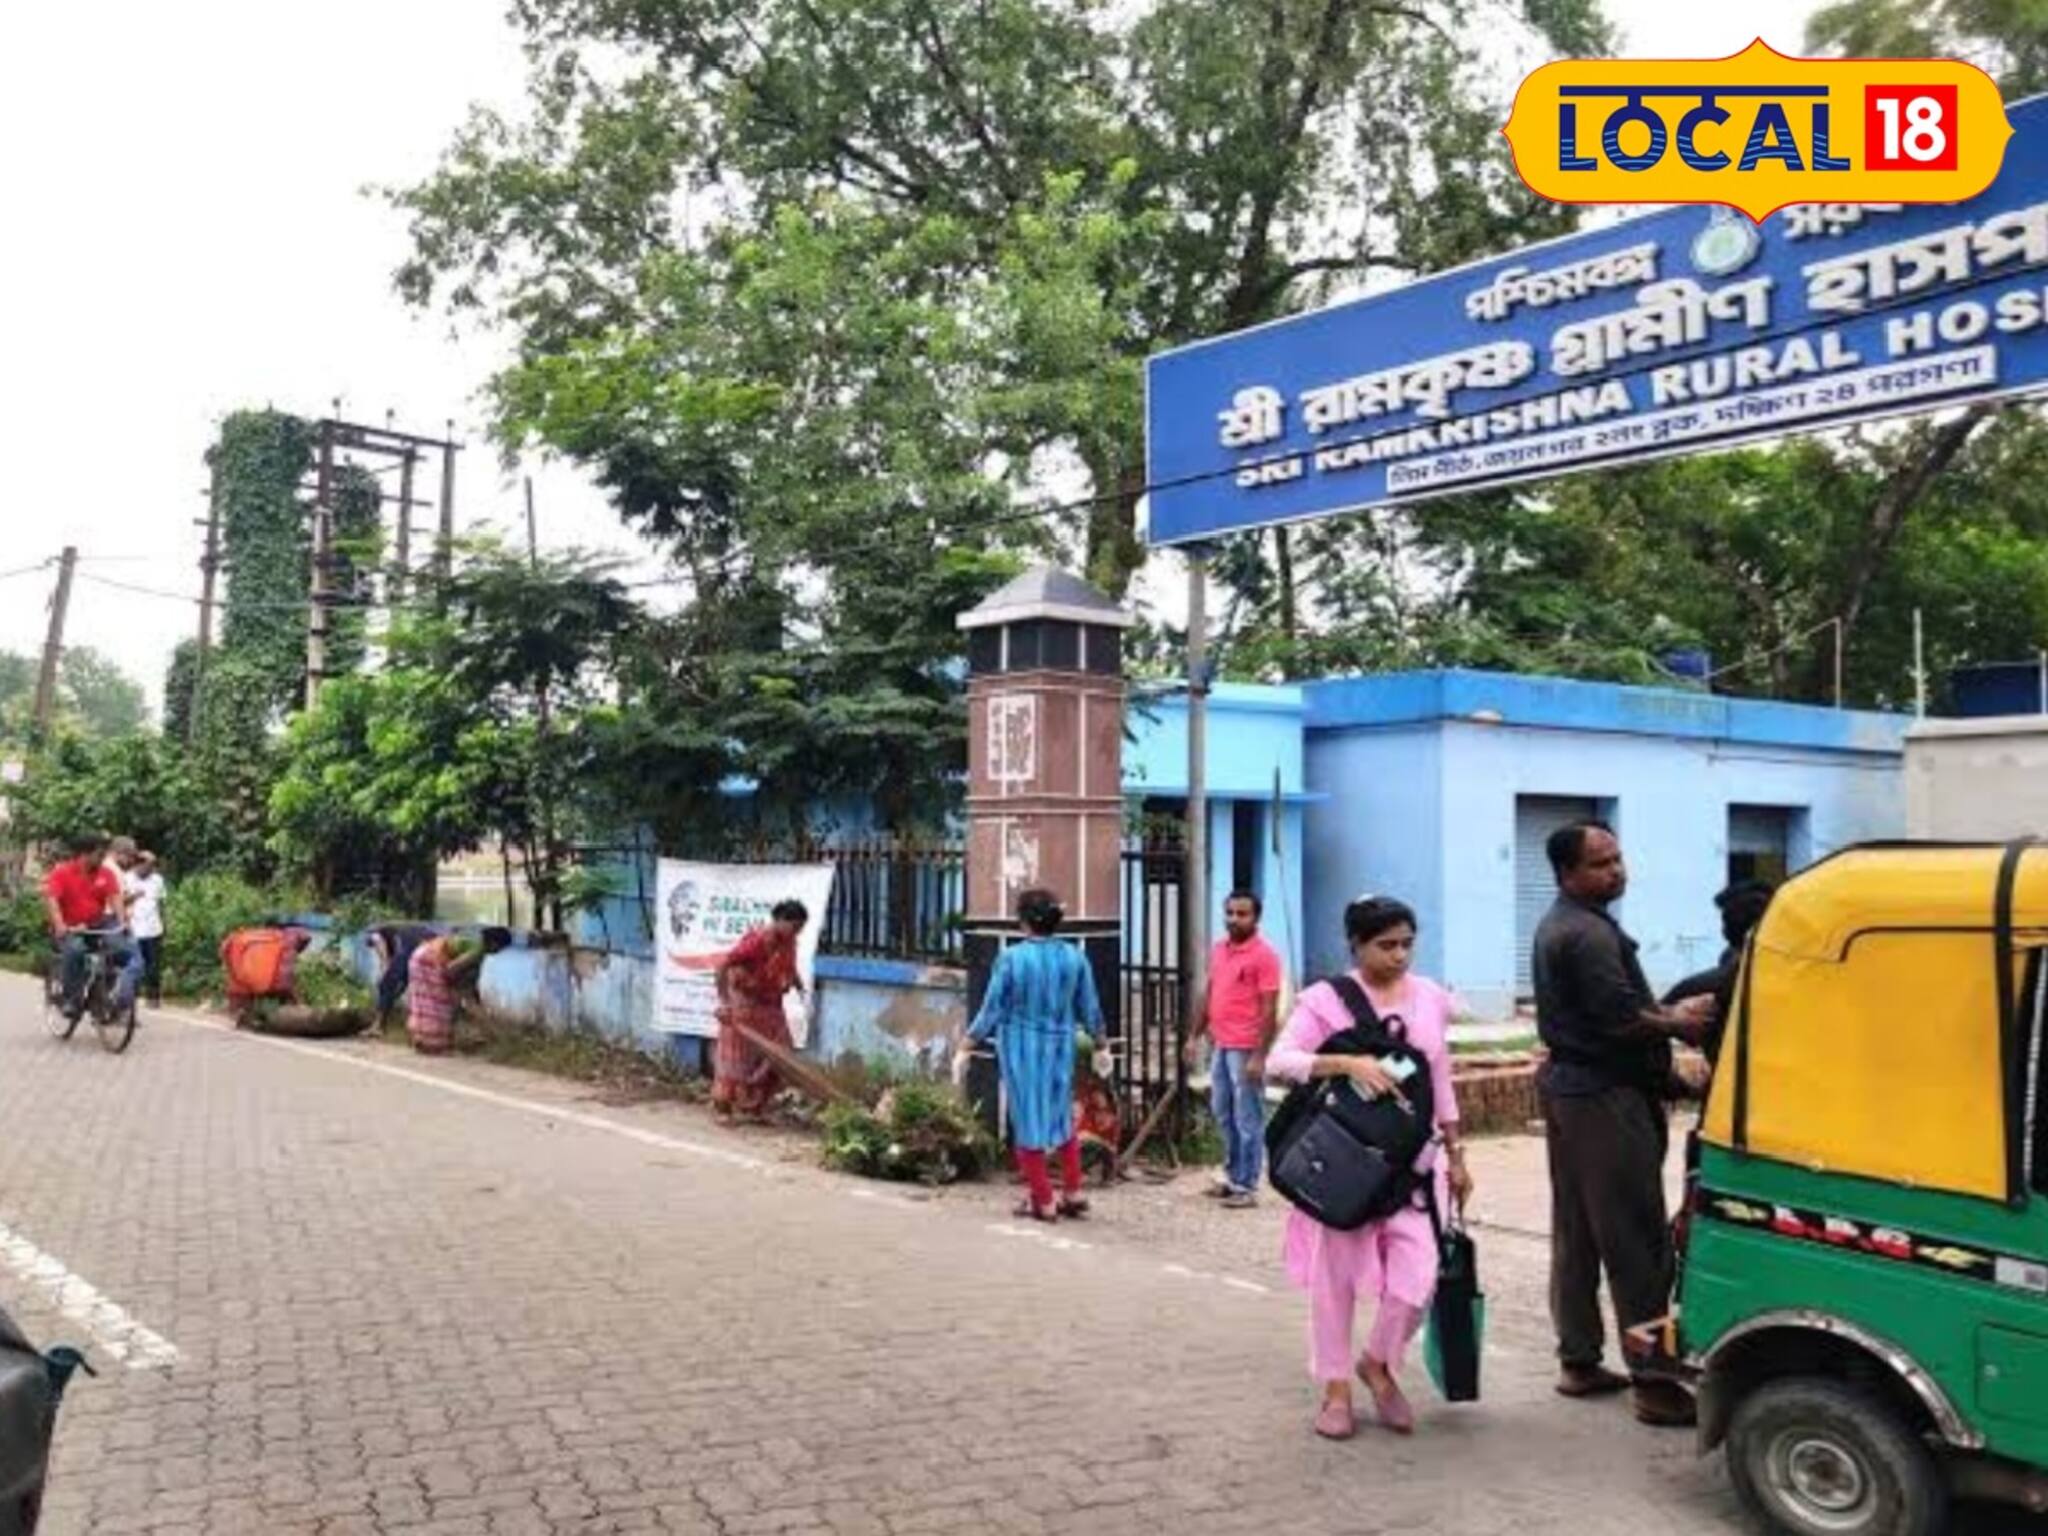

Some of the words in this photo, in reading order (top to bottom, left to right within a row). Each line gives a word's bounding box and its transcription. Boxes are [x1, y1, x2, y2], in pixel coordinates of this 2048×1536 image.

[1217, 386, 1284, 447] শ্রী
[1300, 341, 1534, 433] রামকৃষ্ণ
[1551, 277, 1776, 375] গ্রামীণ
[1465, 241, 1658, 320] পশ্চিমবঙ্গ
[1237, 451, 1302, 487] SRI
[1651, 332, 1860, 405] RURAL
[1885, 285, 2048, 356] HOS
